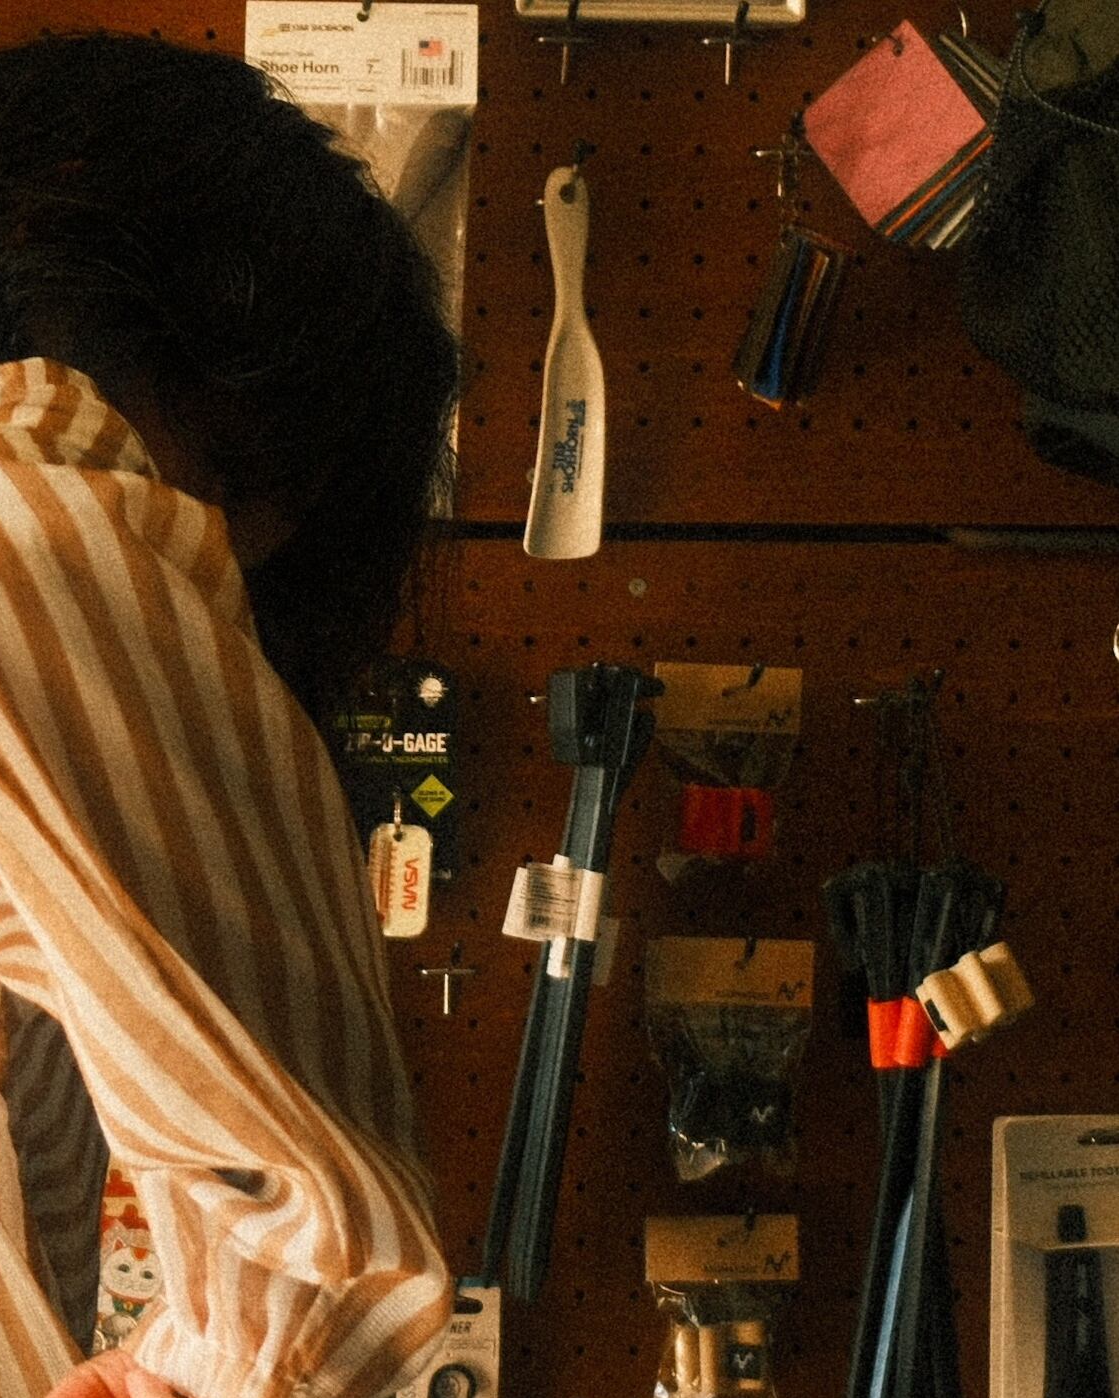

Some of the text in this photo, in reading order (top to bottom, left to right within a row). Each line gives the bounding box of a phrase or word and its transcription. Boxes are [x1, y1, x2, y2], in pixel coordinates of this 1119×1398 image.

[260, 60, 339, 73] Shoe Horn
[402, 857, 420, 910] NASA
